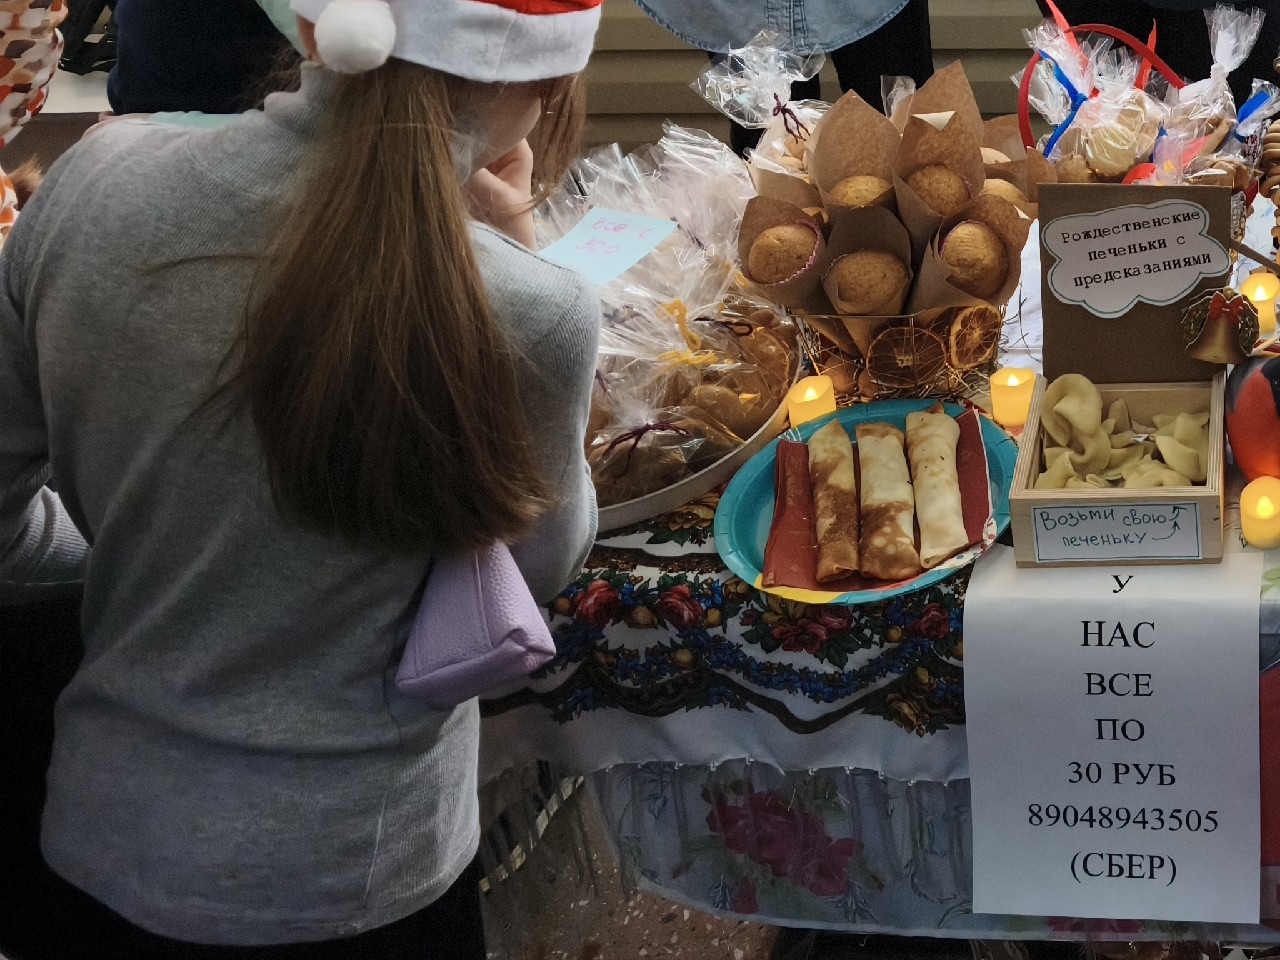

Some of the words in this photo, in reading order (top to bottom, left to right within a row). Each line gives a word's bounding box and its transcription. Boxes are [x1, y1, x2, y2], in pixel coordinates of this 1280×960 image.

[1061, 210, 1201, 244] Рождественские
[1088, 238, 1168, 262] печеньки
[1176, 235, 1186, 246] с
[1073, 253, 1212, 289] предсказаниями
[1040, 509, 1115, 531] Возьми
[1122, 509, 1167, 527] свою
[1062, 532, 1148, 547] печеньку
[1111, 574, 1135, 594] У
[1080, 620, 1156, 649] НАС
[1083, 672, 1154, 697] ВСЕ
[1094, 718, 1145, 741] ПО
[1067, 761, 1102, 784] 30
[1111, 763, 1177, 787] РУБ
[1028, 803, 1219, 833] 89048943505
[1070, 851, 1177, 887] (СБЕР)
